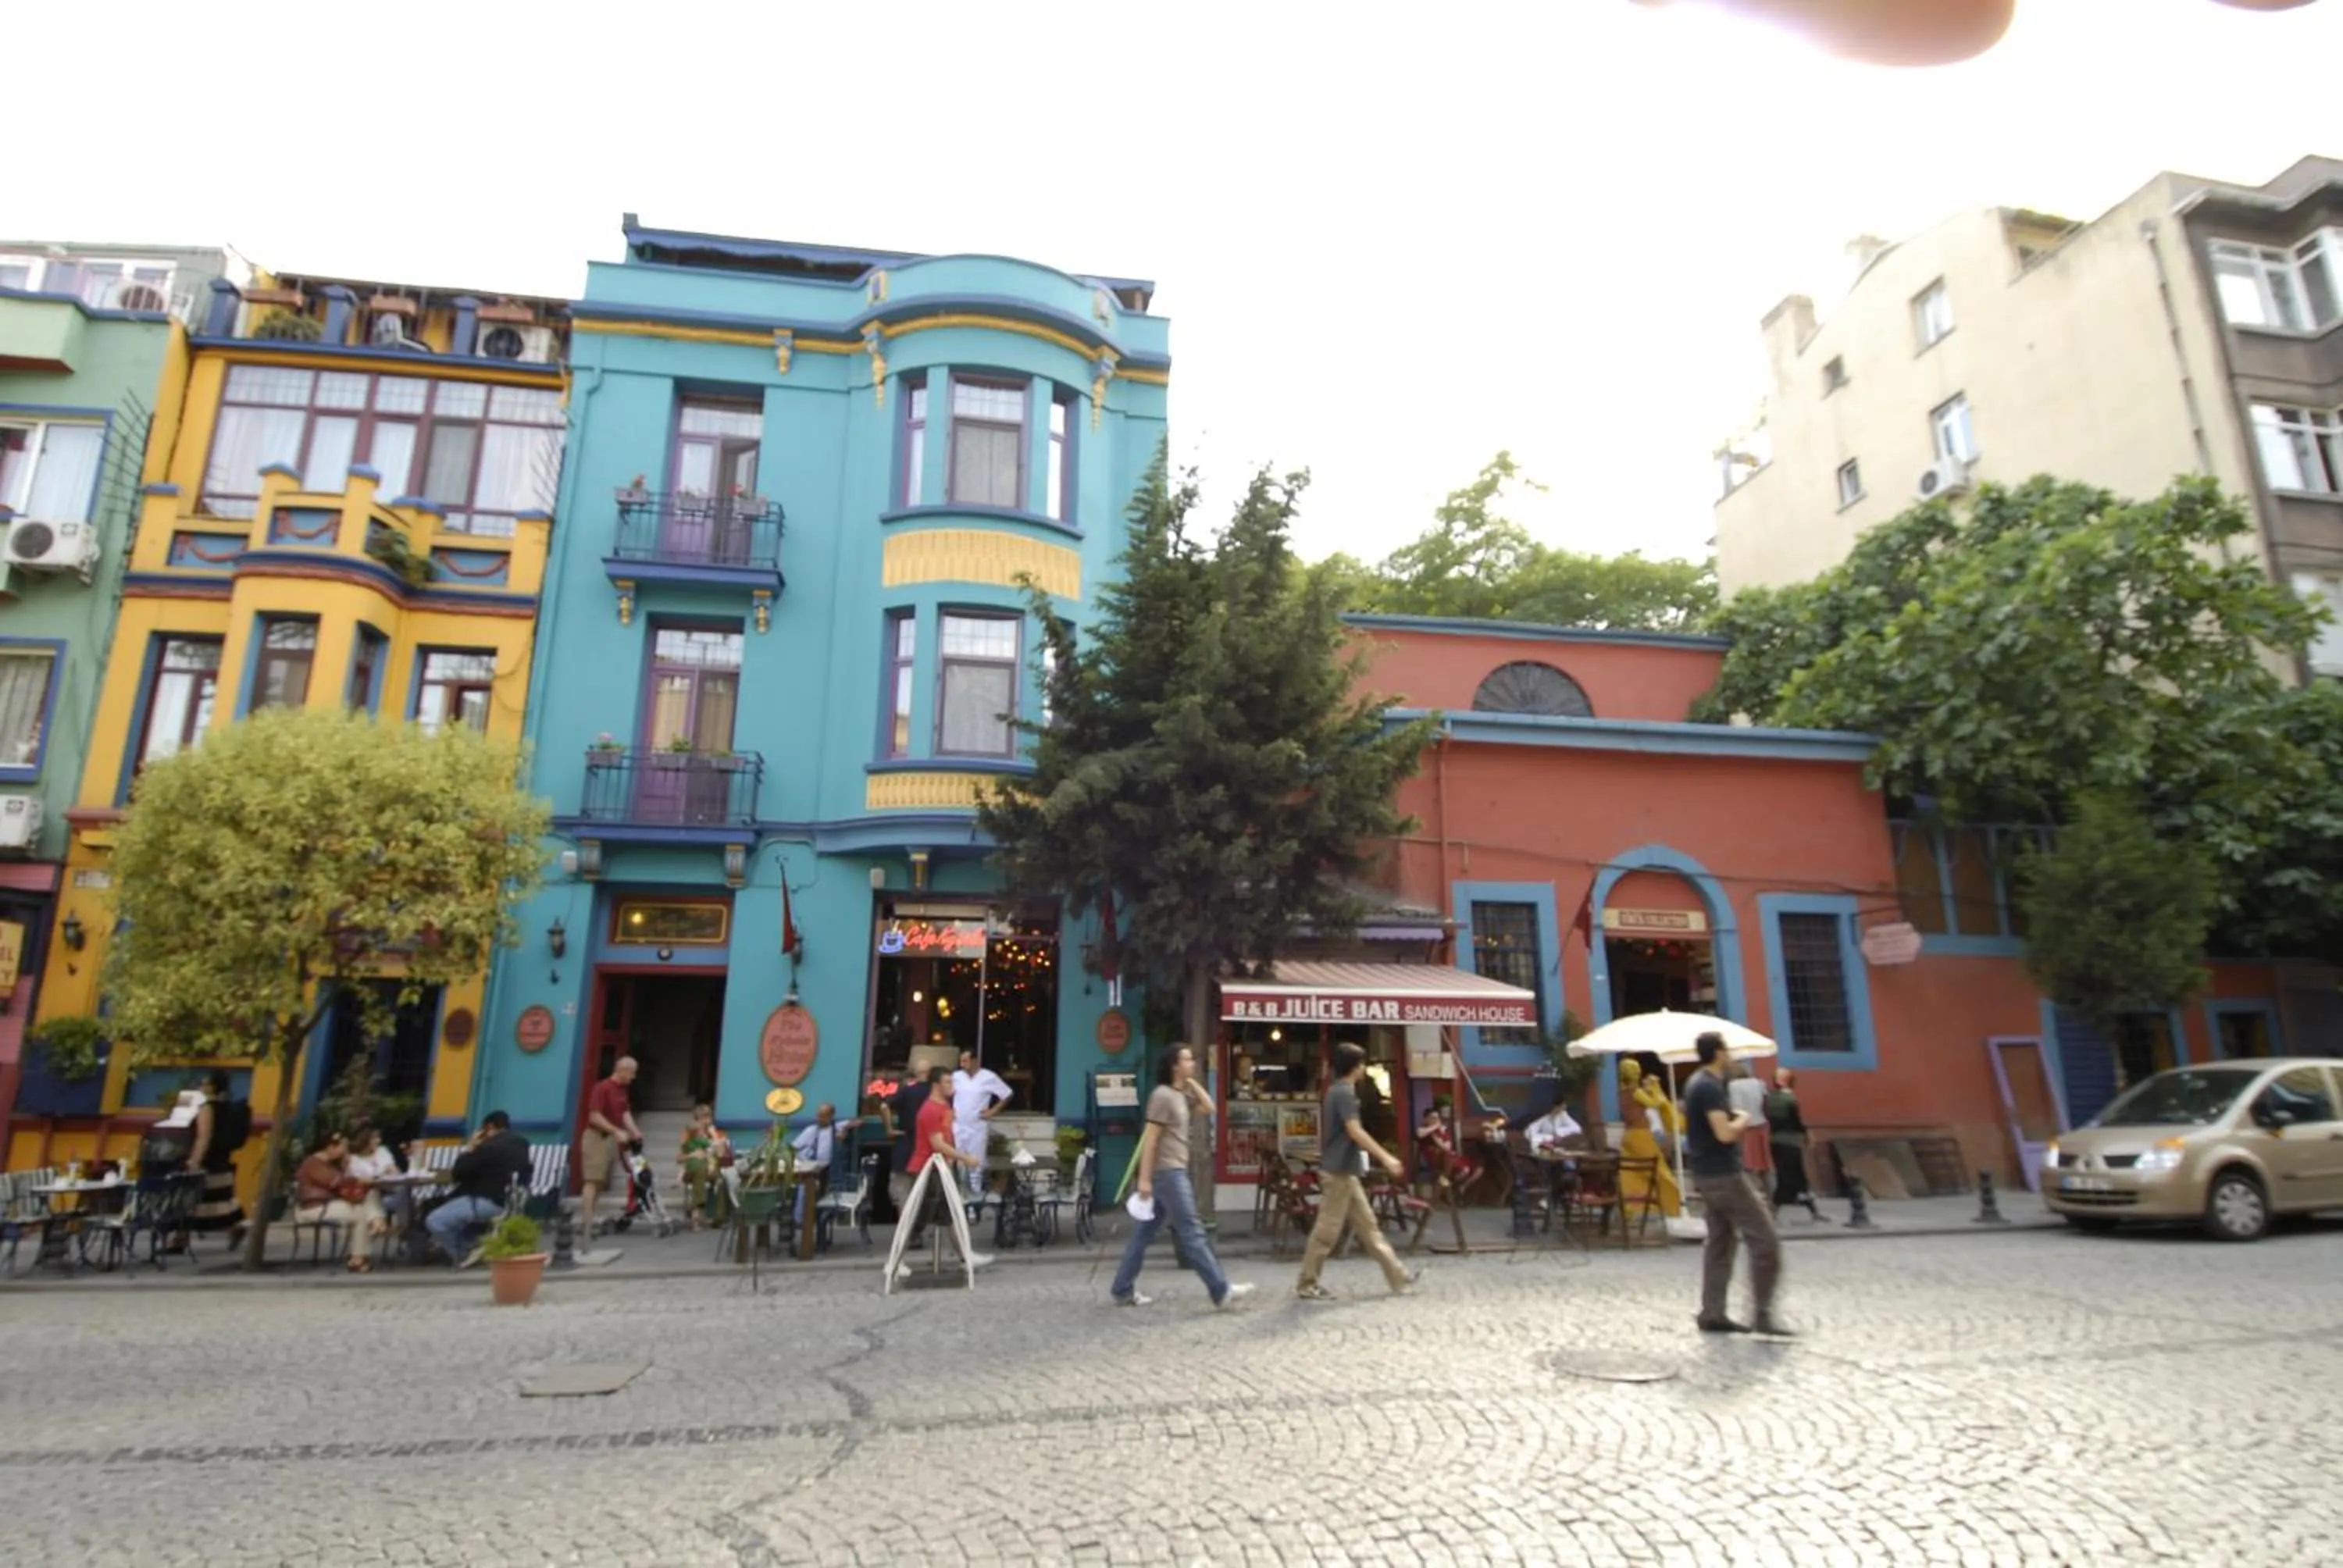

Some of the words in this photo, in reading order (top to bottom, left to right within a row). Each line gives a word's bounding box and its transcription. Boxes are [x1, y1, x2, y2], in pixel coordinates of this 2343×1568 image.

[1351, 1000, 1400, 1019] BAR
[1404, 1004, 1475, 1021] SANDWICH
[1478, 1007, 1525, 1022] HOUSE
